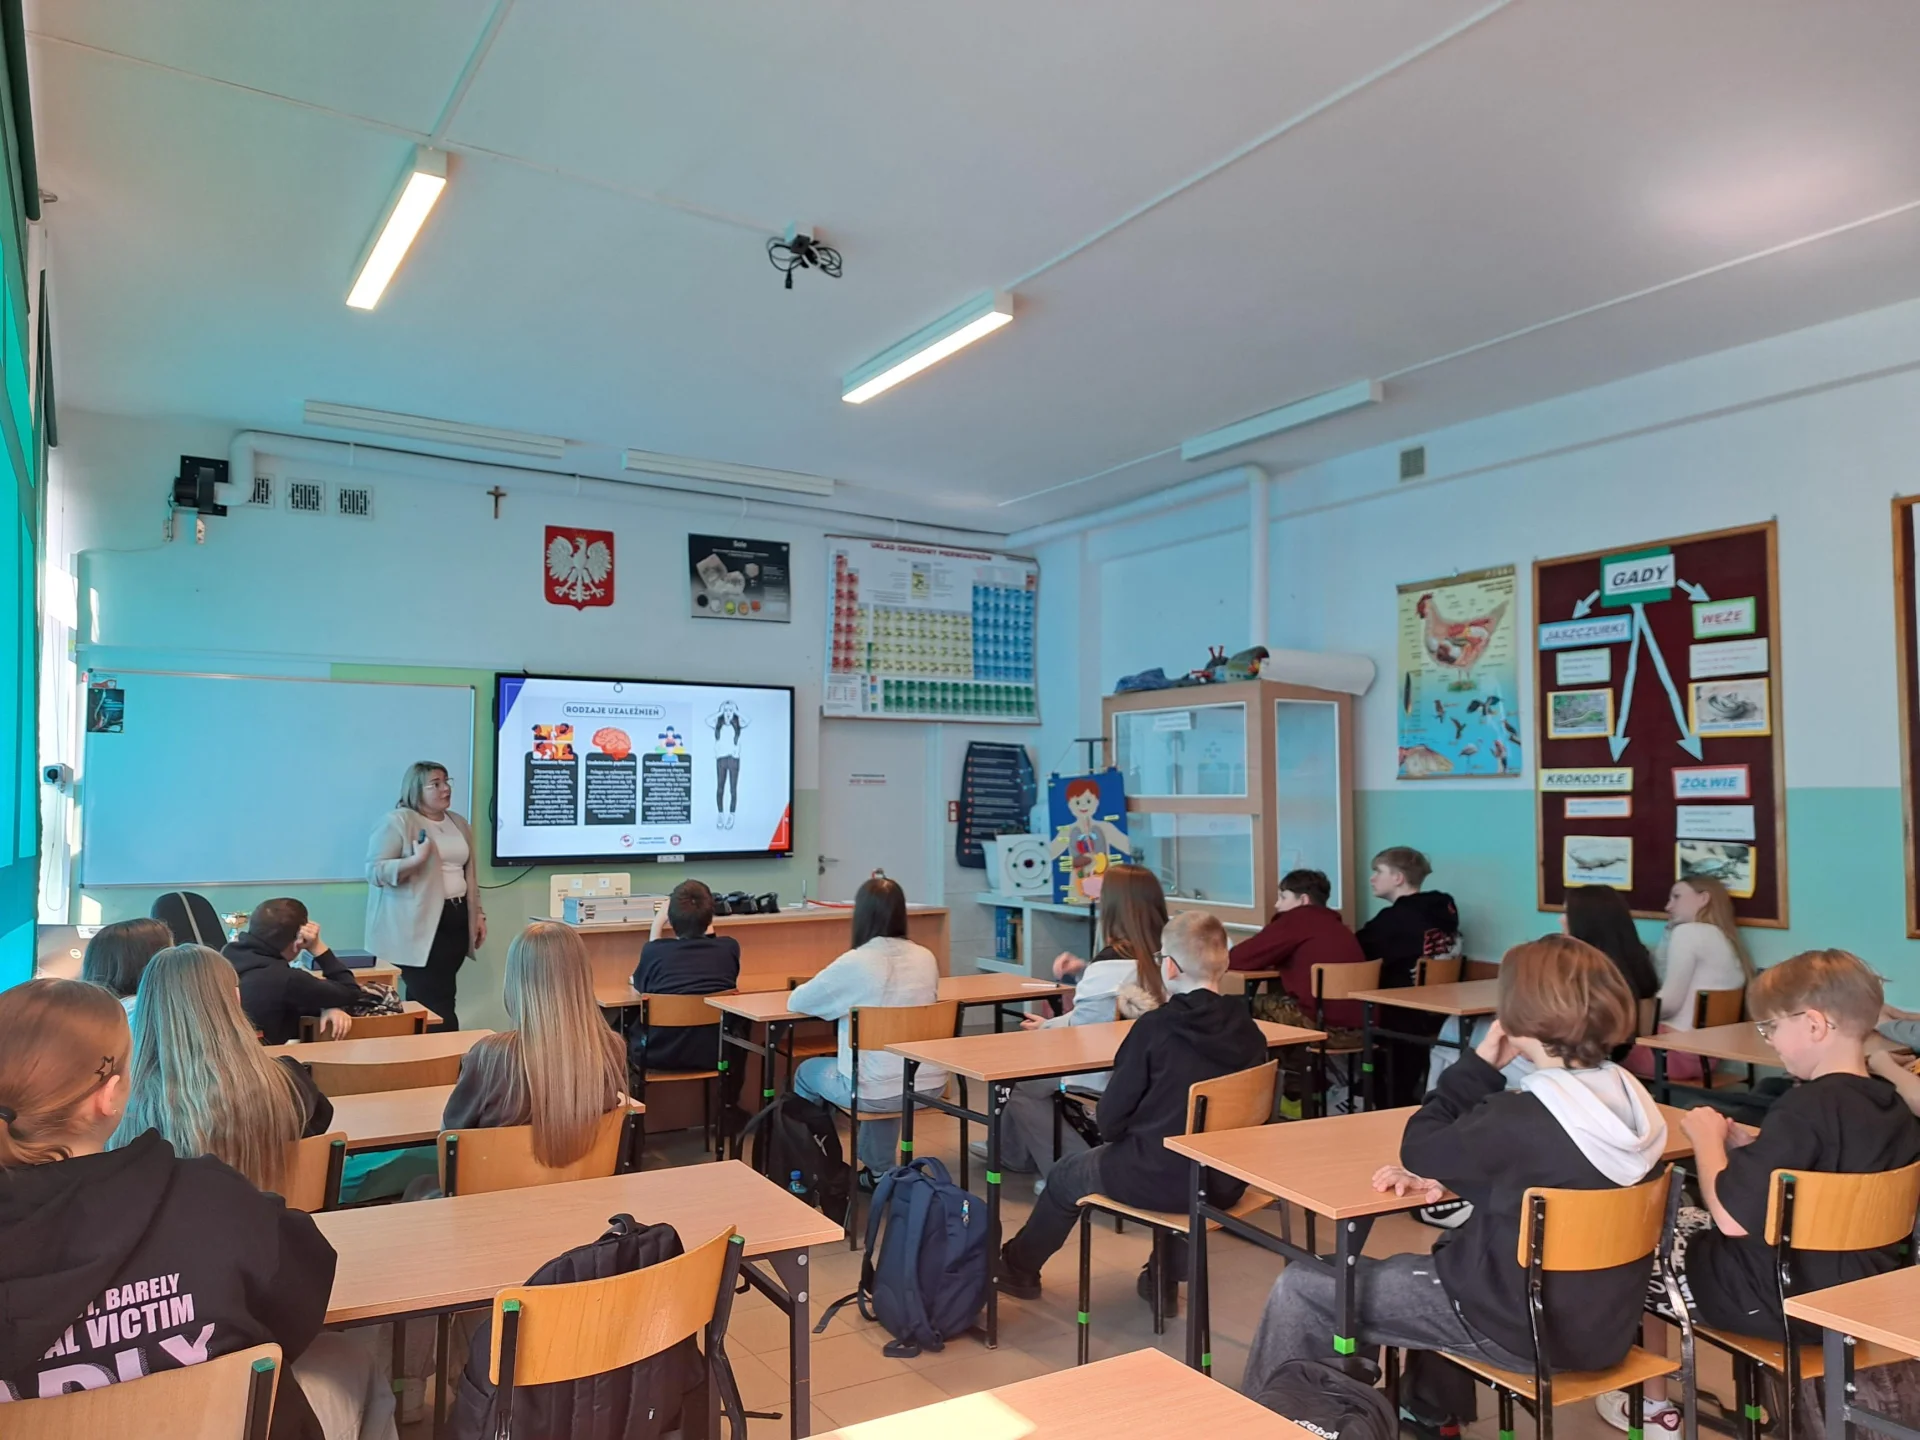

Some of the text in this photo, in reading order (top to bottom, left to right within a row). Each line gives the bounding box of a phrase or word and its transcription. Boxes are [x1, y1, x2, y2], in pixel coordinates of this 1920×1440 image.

[1613, 564, 1669, 585] GADY
[1545, 621, 1626, 642] JASZCZURKI
[566, 706, 659, 716] RODZAJE UZALEŻNIEŃ
[1547, 772, 1627, 785] KROKODYLE
[105, 1272, 180, 1311] BARELY
[86, 1293, 195, 1349] VICTIM
